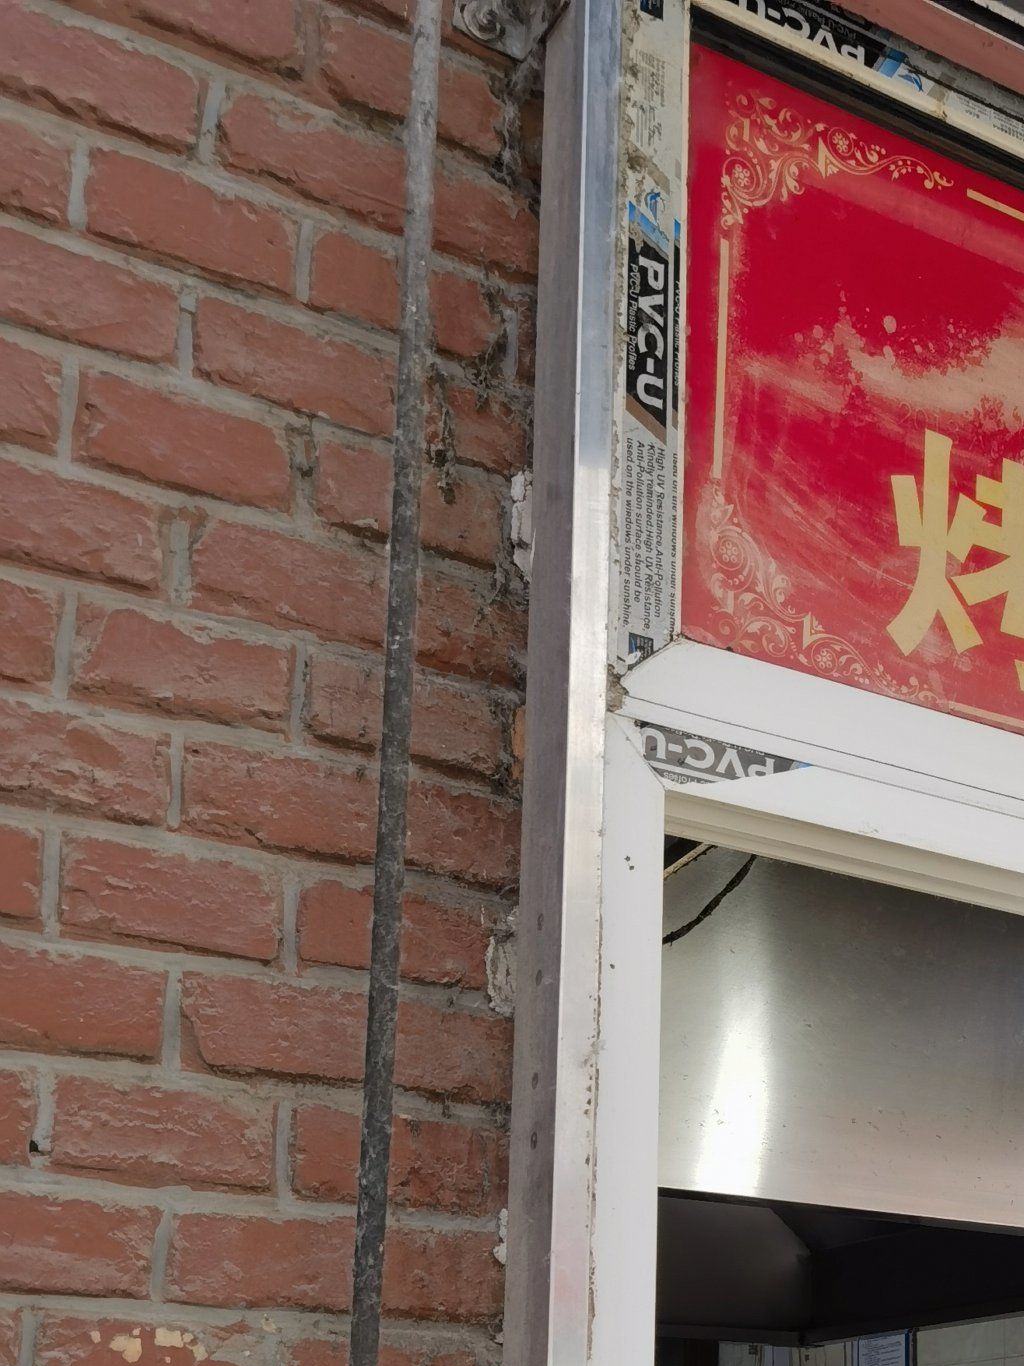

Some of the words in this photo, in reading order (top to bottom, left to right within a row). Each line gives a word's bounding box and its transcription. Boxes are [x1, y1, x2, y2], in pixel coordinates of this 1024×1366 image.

[629, 264, 638, 298] PVC-U
[628, 300, 638, 332] Plastic
[637, 255, 665, 409] PVC-U
[628, 335, 637, 370] Profiles
[625, 438, 635, 462] used
[645, 443, 655, 474] Kindly
[656, 448, 665, 470] High
[625, 465, 633, 477] on
[636, 441, 645, 509] Anti-Pollution
[656, 474, 664, 489] UV
[625, 480, 634, 496] the
[624, 499, 633, 543] windows
[635, 513, 644, 550] surface
[624, 547, 633, 576] under
[635, 553, 643, 588] should
[645, 556, 653, 570] UV
[622, 579, 632, 627] sunshine.
[634, 590, 642, 602] be
[641, 727, 774, 777] PVC-U
